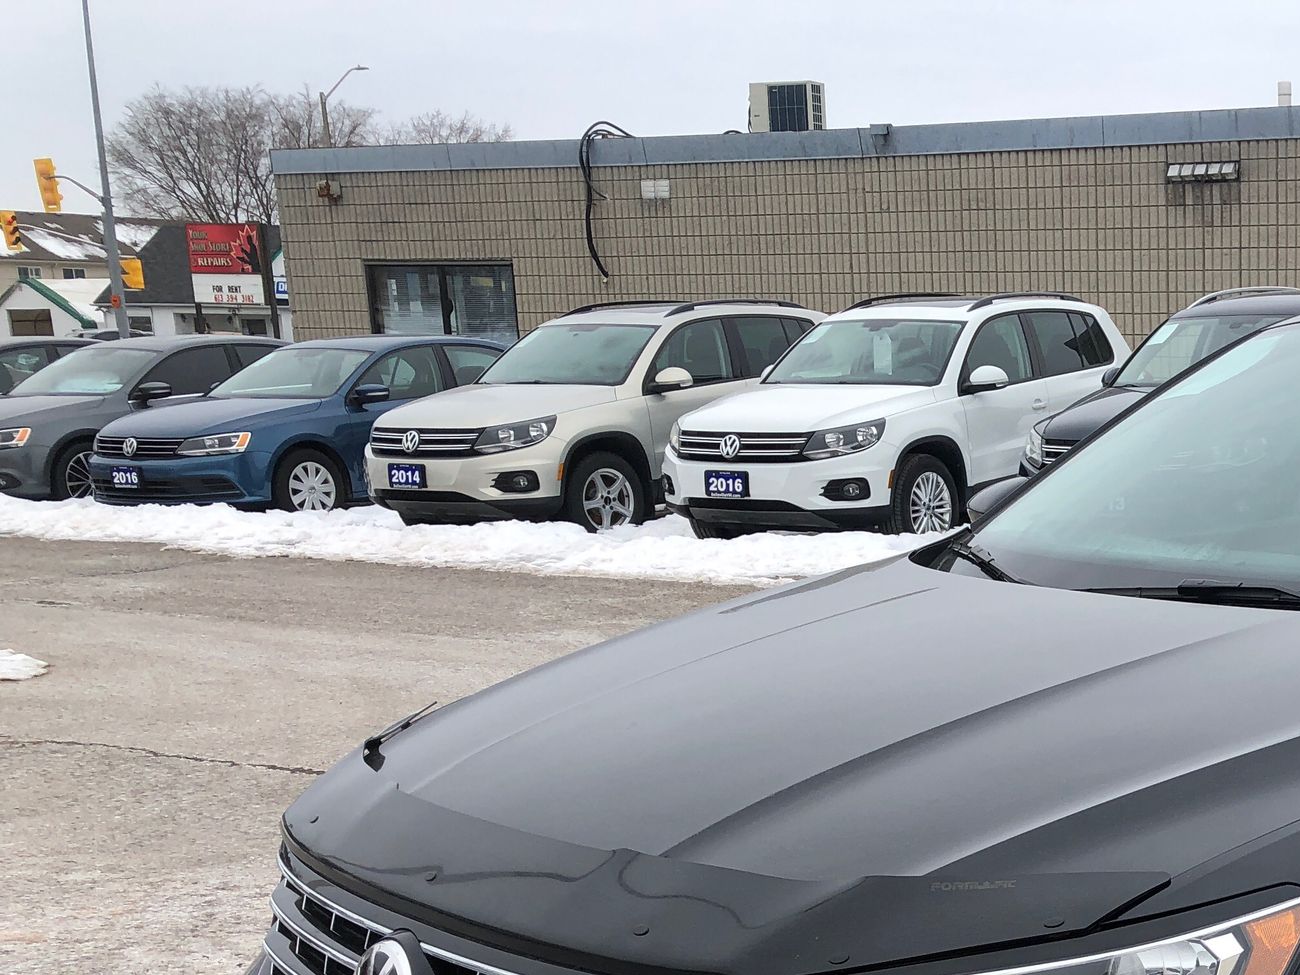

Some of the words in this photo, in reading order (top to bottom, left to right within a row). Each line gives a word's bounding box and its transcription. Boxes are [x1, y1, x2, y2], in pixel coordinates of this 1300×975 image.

[197, 257, 232, 267] REPAIRS
[212, 285, 223, 293] FOR
[227, 285, 241, 293] RENT
[112, 471, 139, 484] 2016
[391, 469, 420, 484] 2014
[708, 477, 743, 493] 2016
